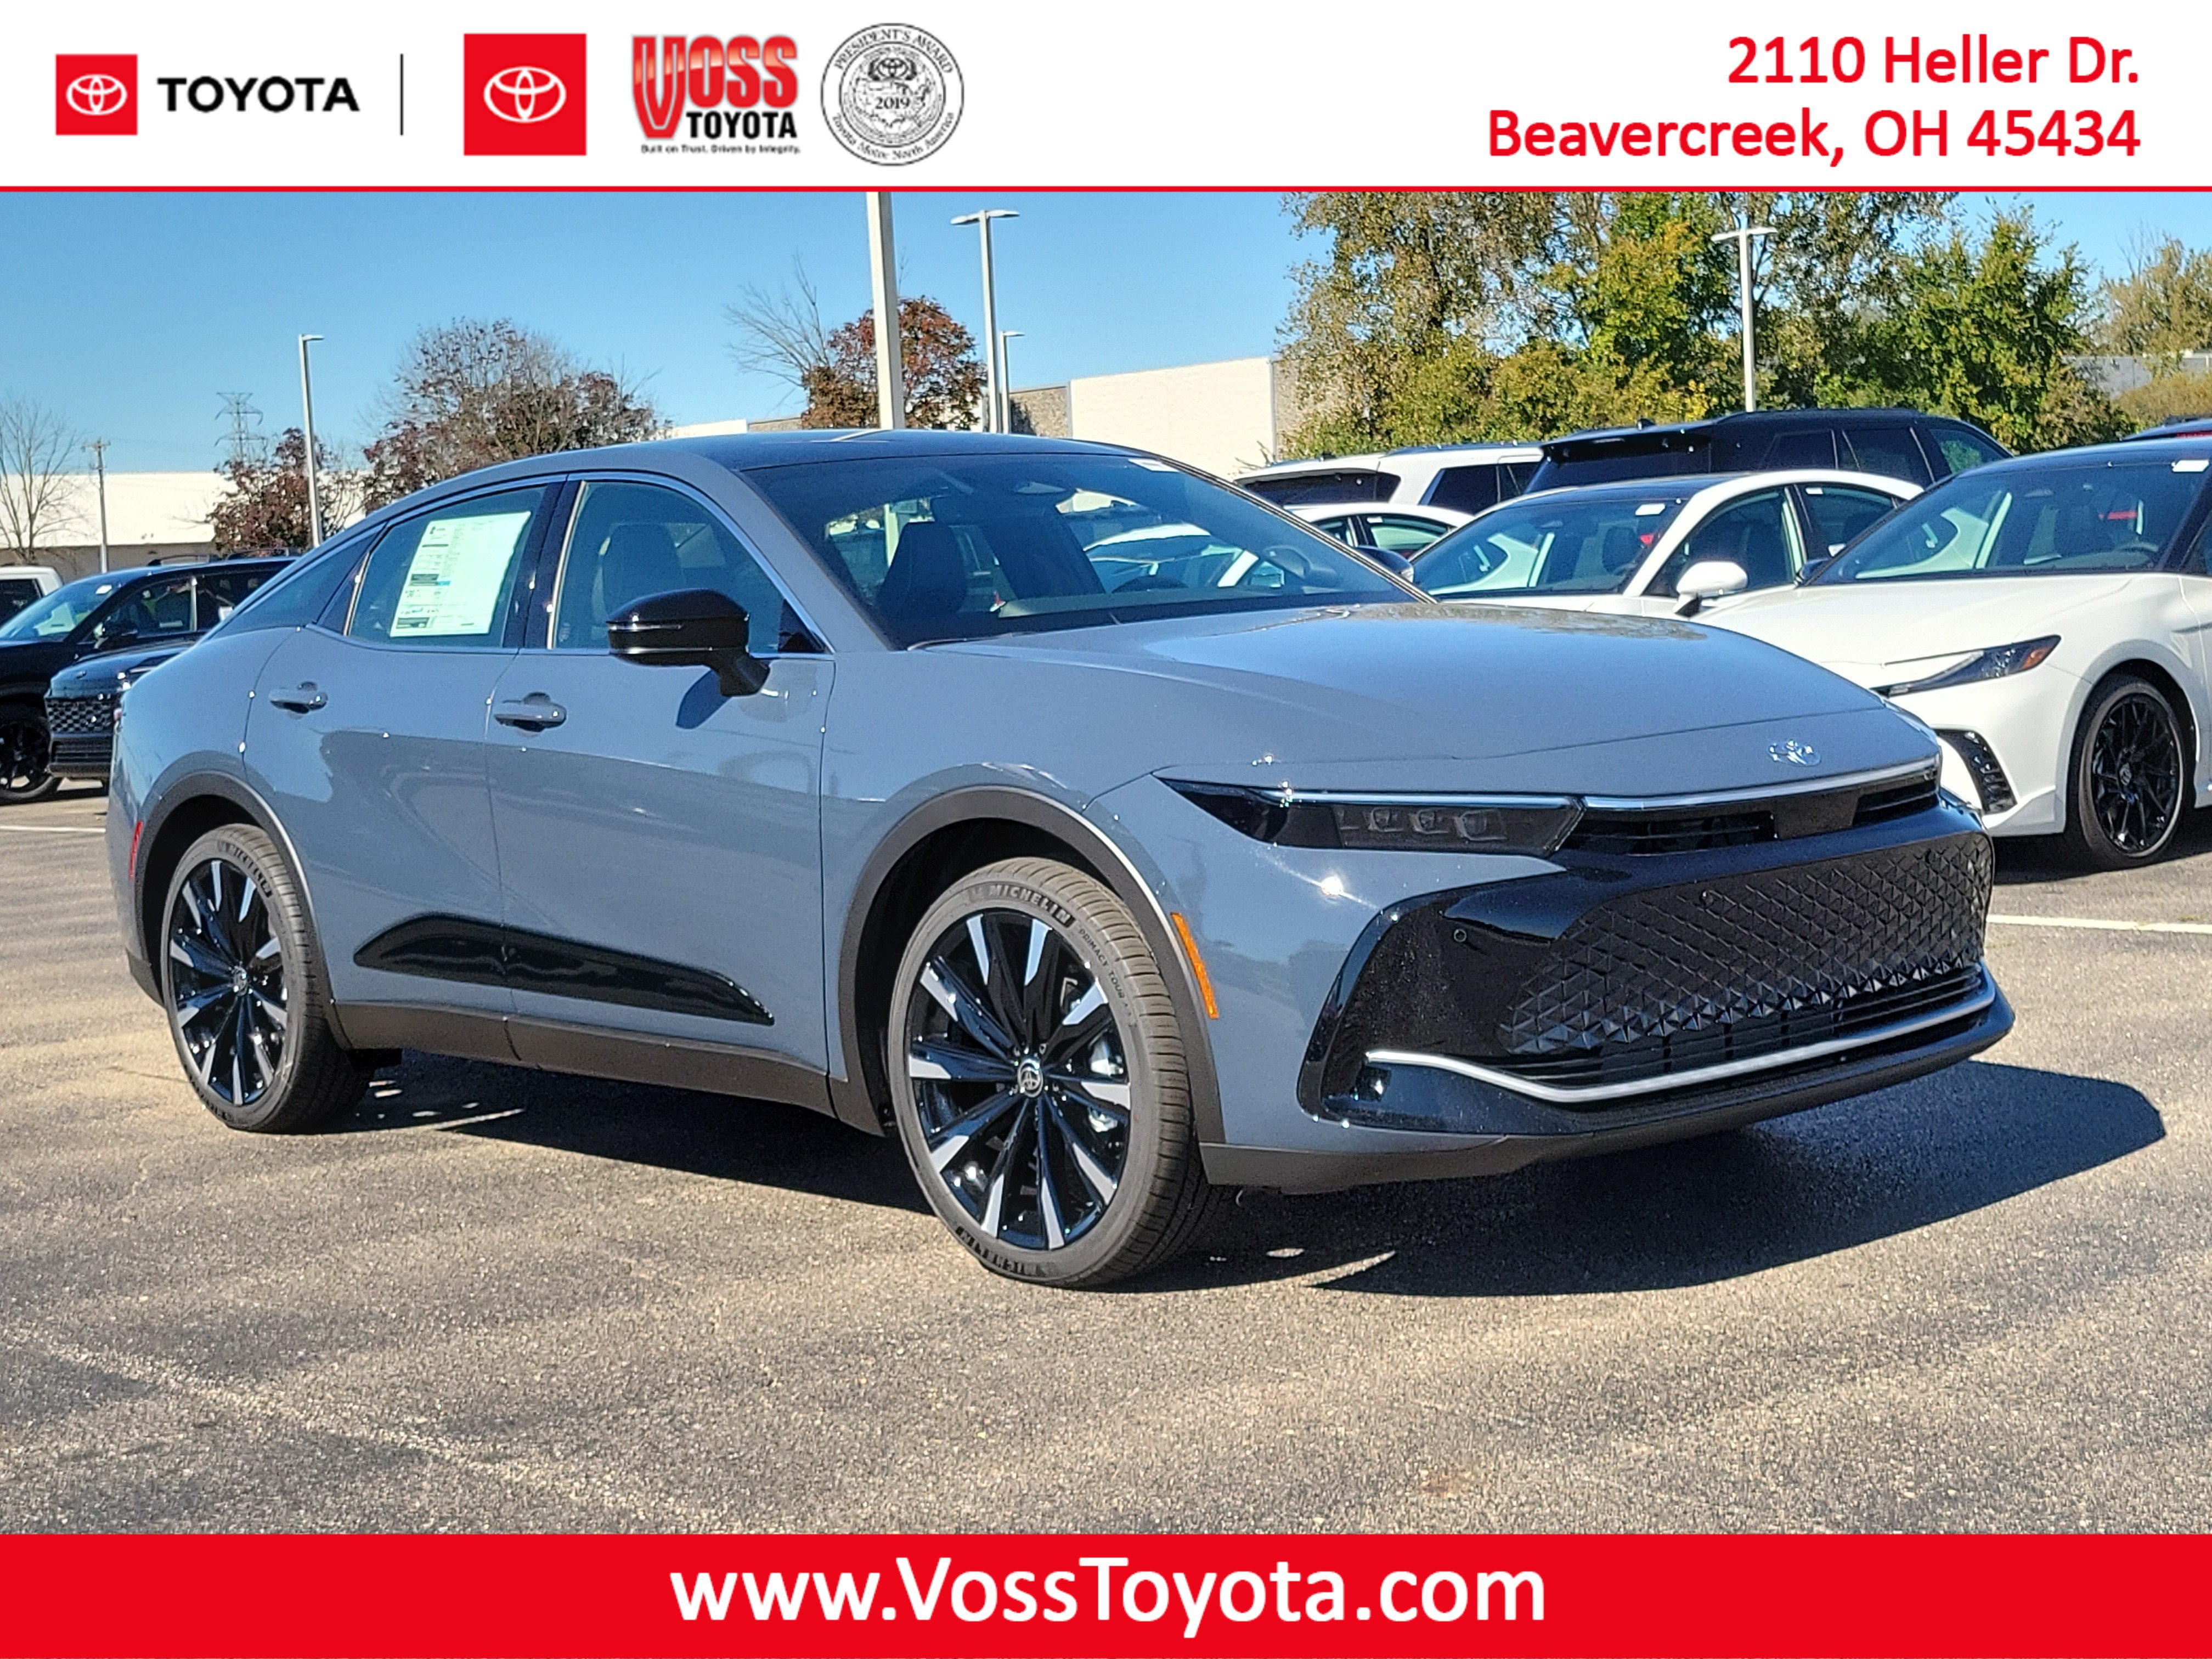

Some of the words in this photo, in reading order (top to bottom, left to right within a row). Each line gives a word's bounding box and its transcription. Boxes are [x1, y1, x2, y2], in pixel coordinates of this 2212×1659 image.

[989, 884, 1071, 924] MICHELIN
[1079, 928, 1109, 967] PRIMACY
[1108, 969, 1125, 998] TOUR
